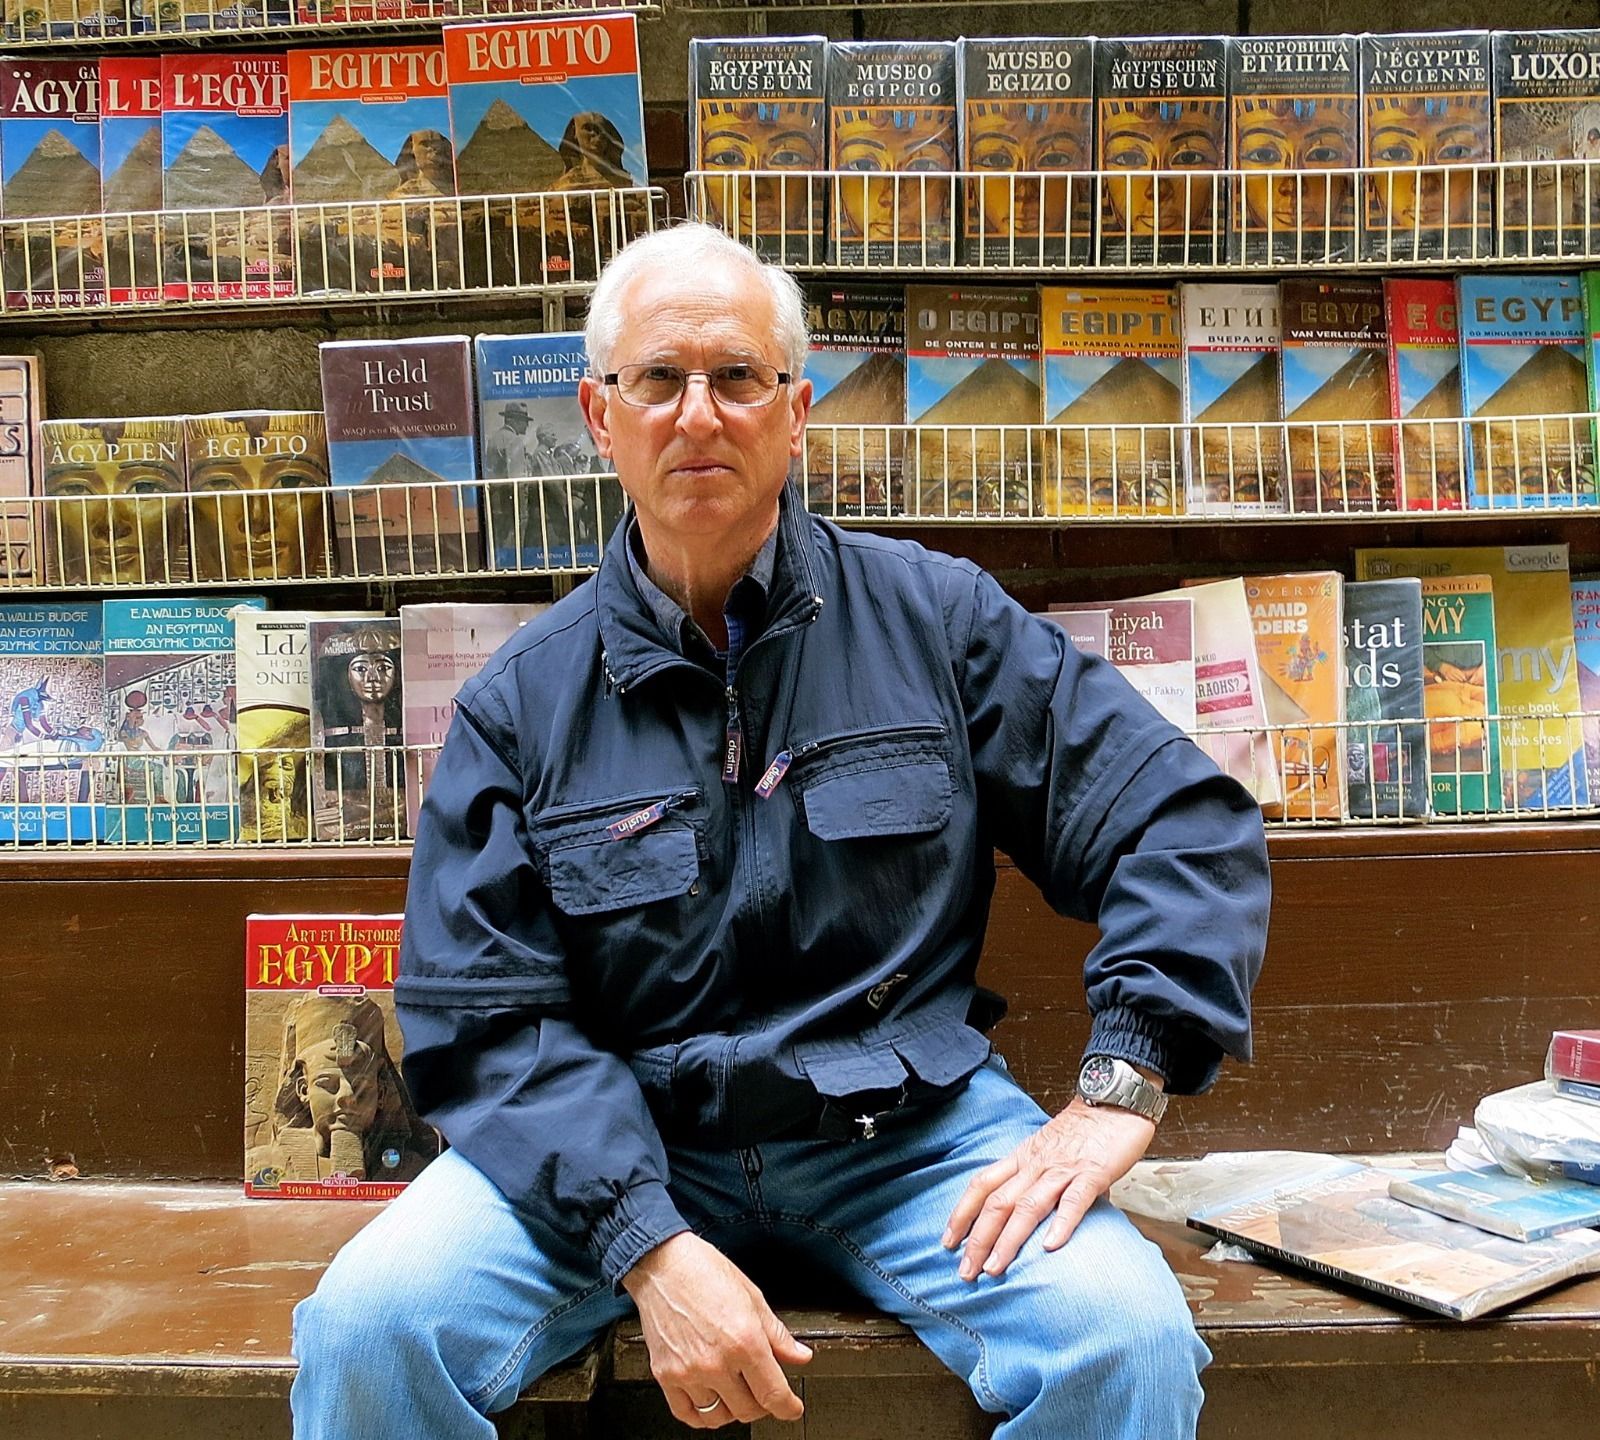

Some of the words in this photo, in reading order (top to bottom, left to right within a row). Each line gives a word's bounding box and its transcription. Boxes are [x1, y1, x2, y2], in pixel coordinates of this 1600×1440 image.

[466, 24, 611, 72] EGITTO
[1242, 41, 1350, 54] СОКРОВИЩА
[233, 61, 281, 74] TOUTE
[709, 59, 813, 76] EGYPTIAN
[986, 51, 1072, 71] MUSEO
[1111, 58, 1218, 74] ÄGYPTISCHEN
[1241, 53, 1351, 72] ЕГИПТА
[310, 51, 447, 91] EGITTO
[857, 64, 932, 81] MUSEO
[1369, 67, 1486, 84] ANCIENNE
[709, 75, 813, 91] MUSEUM
[986, 72, 1072, 93] EGIZIO
[1112, 72, 1216, 89] MUSEUM
[847, 82, 942, 98] EGIPCIO
[1300, 302, 1381, 324] EGYP
[1475, 296, 1584, 323] EGYP
[918, 308, 937, 331] O
[950, 310, 1039, 334] EGIPT
[833, 334, 880, 343] DAMALS
[883, 336, 903, 344] BIS
[1208, 335, 1251, 343] ВЧЕРА
[1255, 335, 1264, 343] И
[1291, 330, 1313, 338] VAN
[1316, 330, 1372, 339] VERLEDEN
[1409, 335, 1443, 343] PRZED
[925, 340, 939, 348] DE
[946, 340, 984, 349] ONTEM
[990, 341, 998, 349] E
[1003, 342, 1018, 350] DE
[1083, 340, 1120, 348] PASADO
[947, 350, 969, 358] Visto
[971, 351, 984, 360] por
[1104, 350, 1121, 358] POR
[362, 357, 429, 386] Held
[492, 370, 521, 386] THE
[524, 367, 580, 385] MIDDLE
[364, 388, 433, 414] Trust
[389, 424, 423, 433] ISLAMIC
[424, 423, 458, 432] WORLD
[50, 441, 178, 464] ÄGYPTEN
[206, 434, 308, 458] EGIPTO
[1507, 551, 1561, 570] Google
[49, 611, 88, 622] BUDGE
[19, 627, 75, 638] EGYPTIAN
[146, 623, 163, 634] AN
[166, 623, 224, 634] EGYPTIAN
[108, 637, 189, 649] HIEROGLYPHIC
[1154, 686, 1186, 698] Fakhry
[1528, 701, 1560, 713] book
[725, 739, 738, 774] dustin
[760, 766, 780, 790] dustin
[617, 811, 650, 832] dustin
[320, 929, 336, 943] ET
[255, 943, 401, 986] EGYPT
[286, 1186, 313, 1196] 5000
[316, 1188, 332, 1196] ans
[336, 1186, 347, 1196] de
